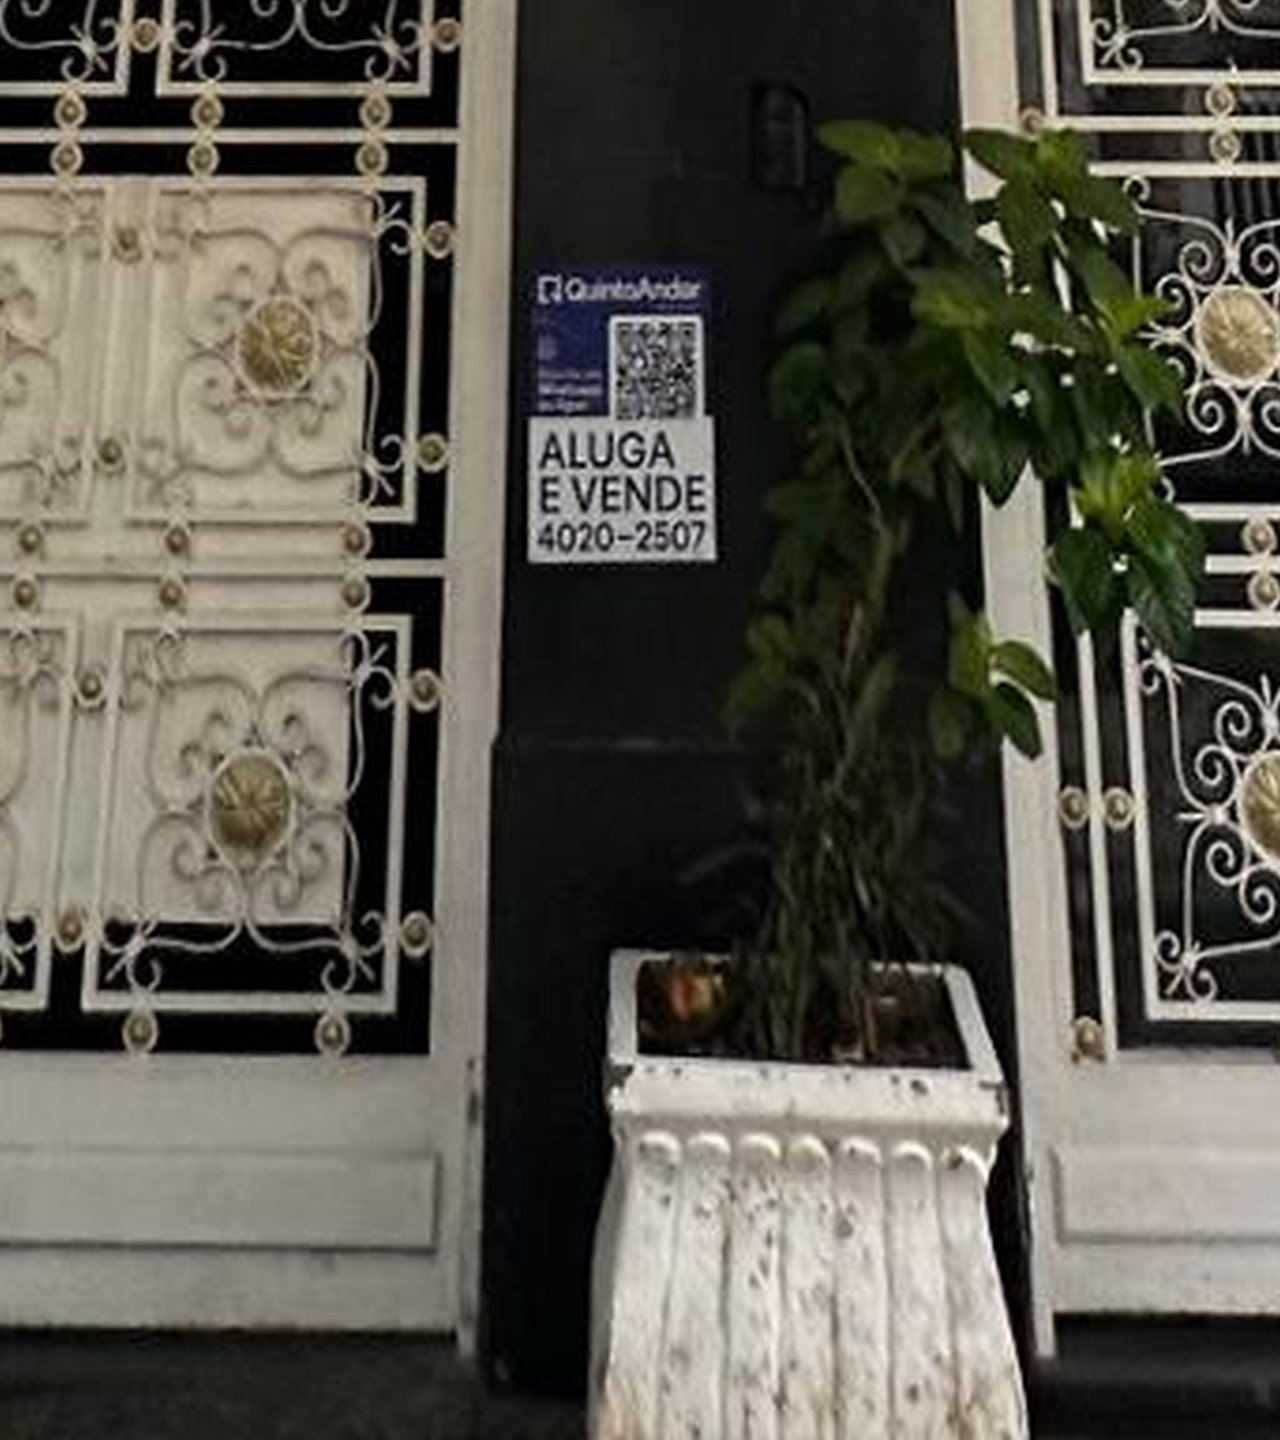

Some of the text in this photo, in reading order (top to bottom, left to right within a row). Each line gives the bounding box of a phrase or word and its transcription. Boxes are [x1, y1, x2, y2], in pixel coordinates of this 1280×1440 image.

[539, 431, 676, 470] ALUGA
[541, 475, 707, 514] E VENDE
[537, 520, 707, 554] 4020-2507
